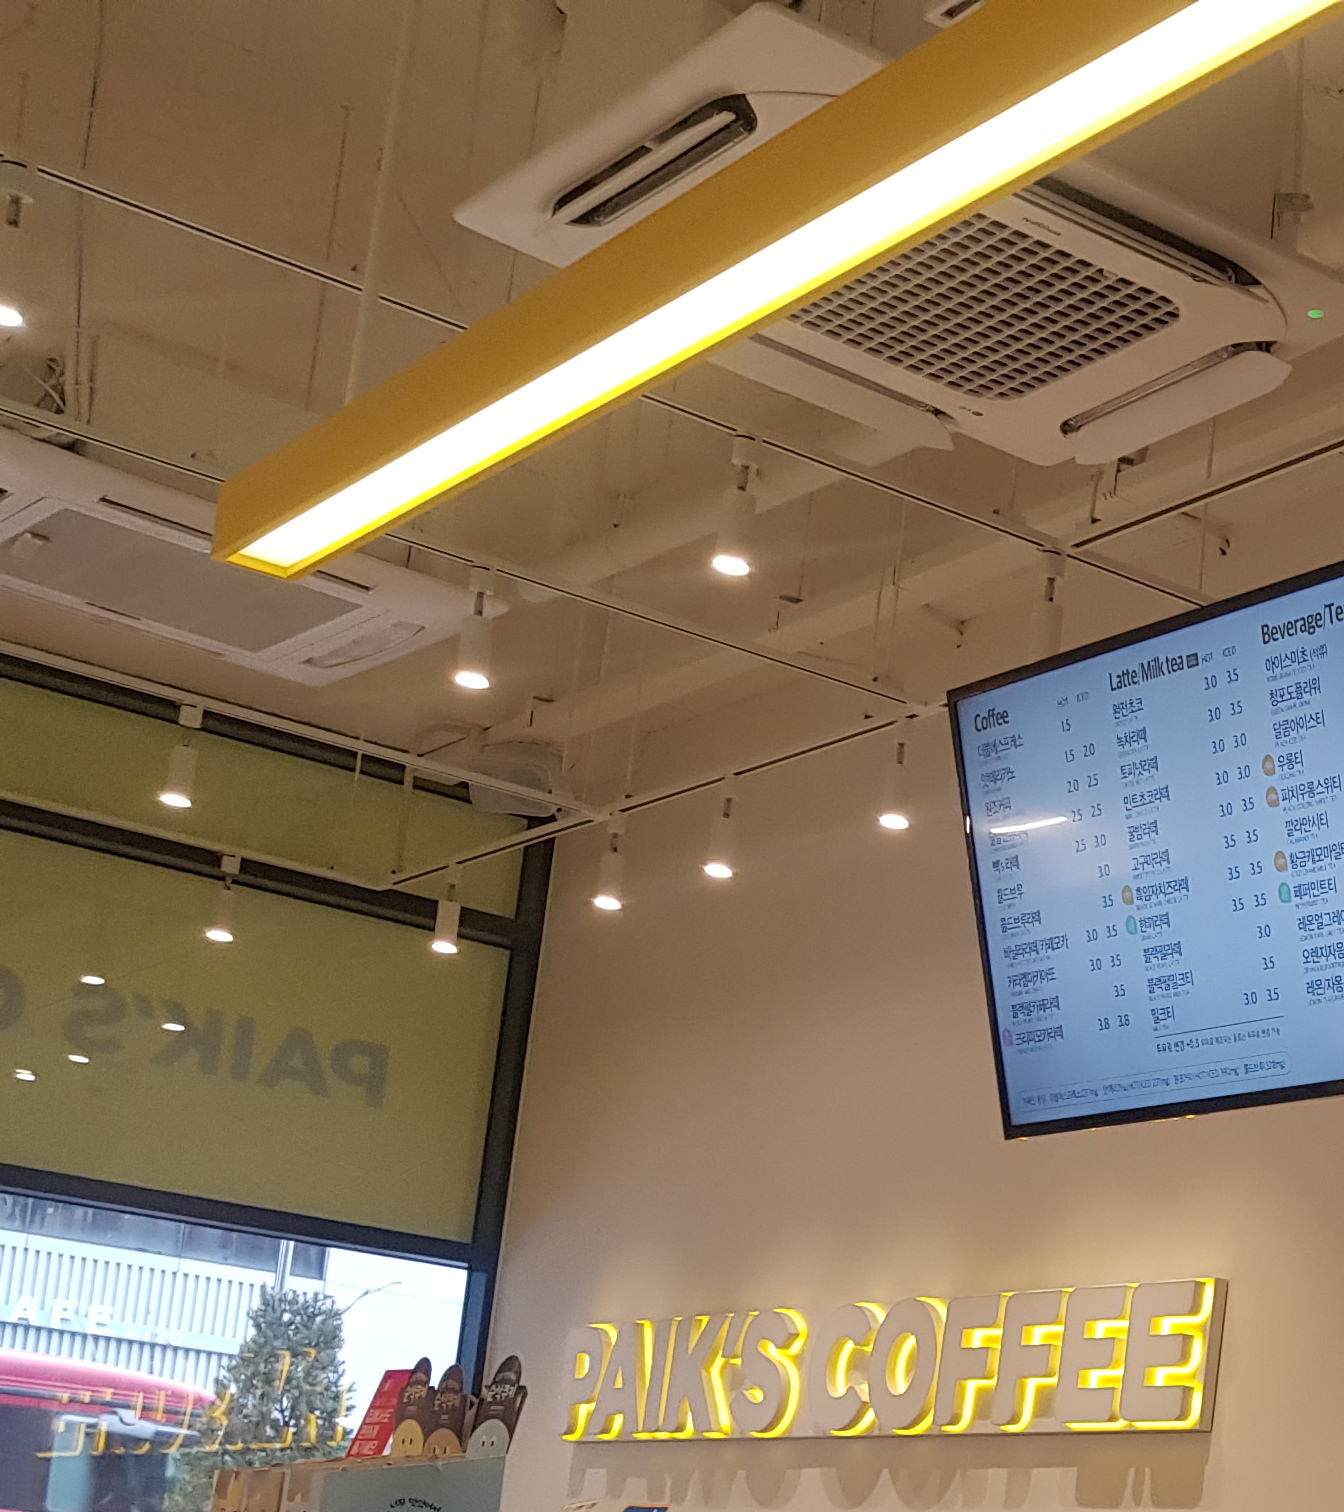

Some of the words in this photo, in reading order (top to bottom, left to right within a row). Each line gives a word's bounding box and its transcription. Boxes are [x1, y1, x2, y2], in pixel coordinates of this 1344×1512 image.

[974, 708, 1010, 732] Coffee
[561, 1308, 809, 1441] PAIK'S
[810, 1278, 1215, 1436] COFFEE
